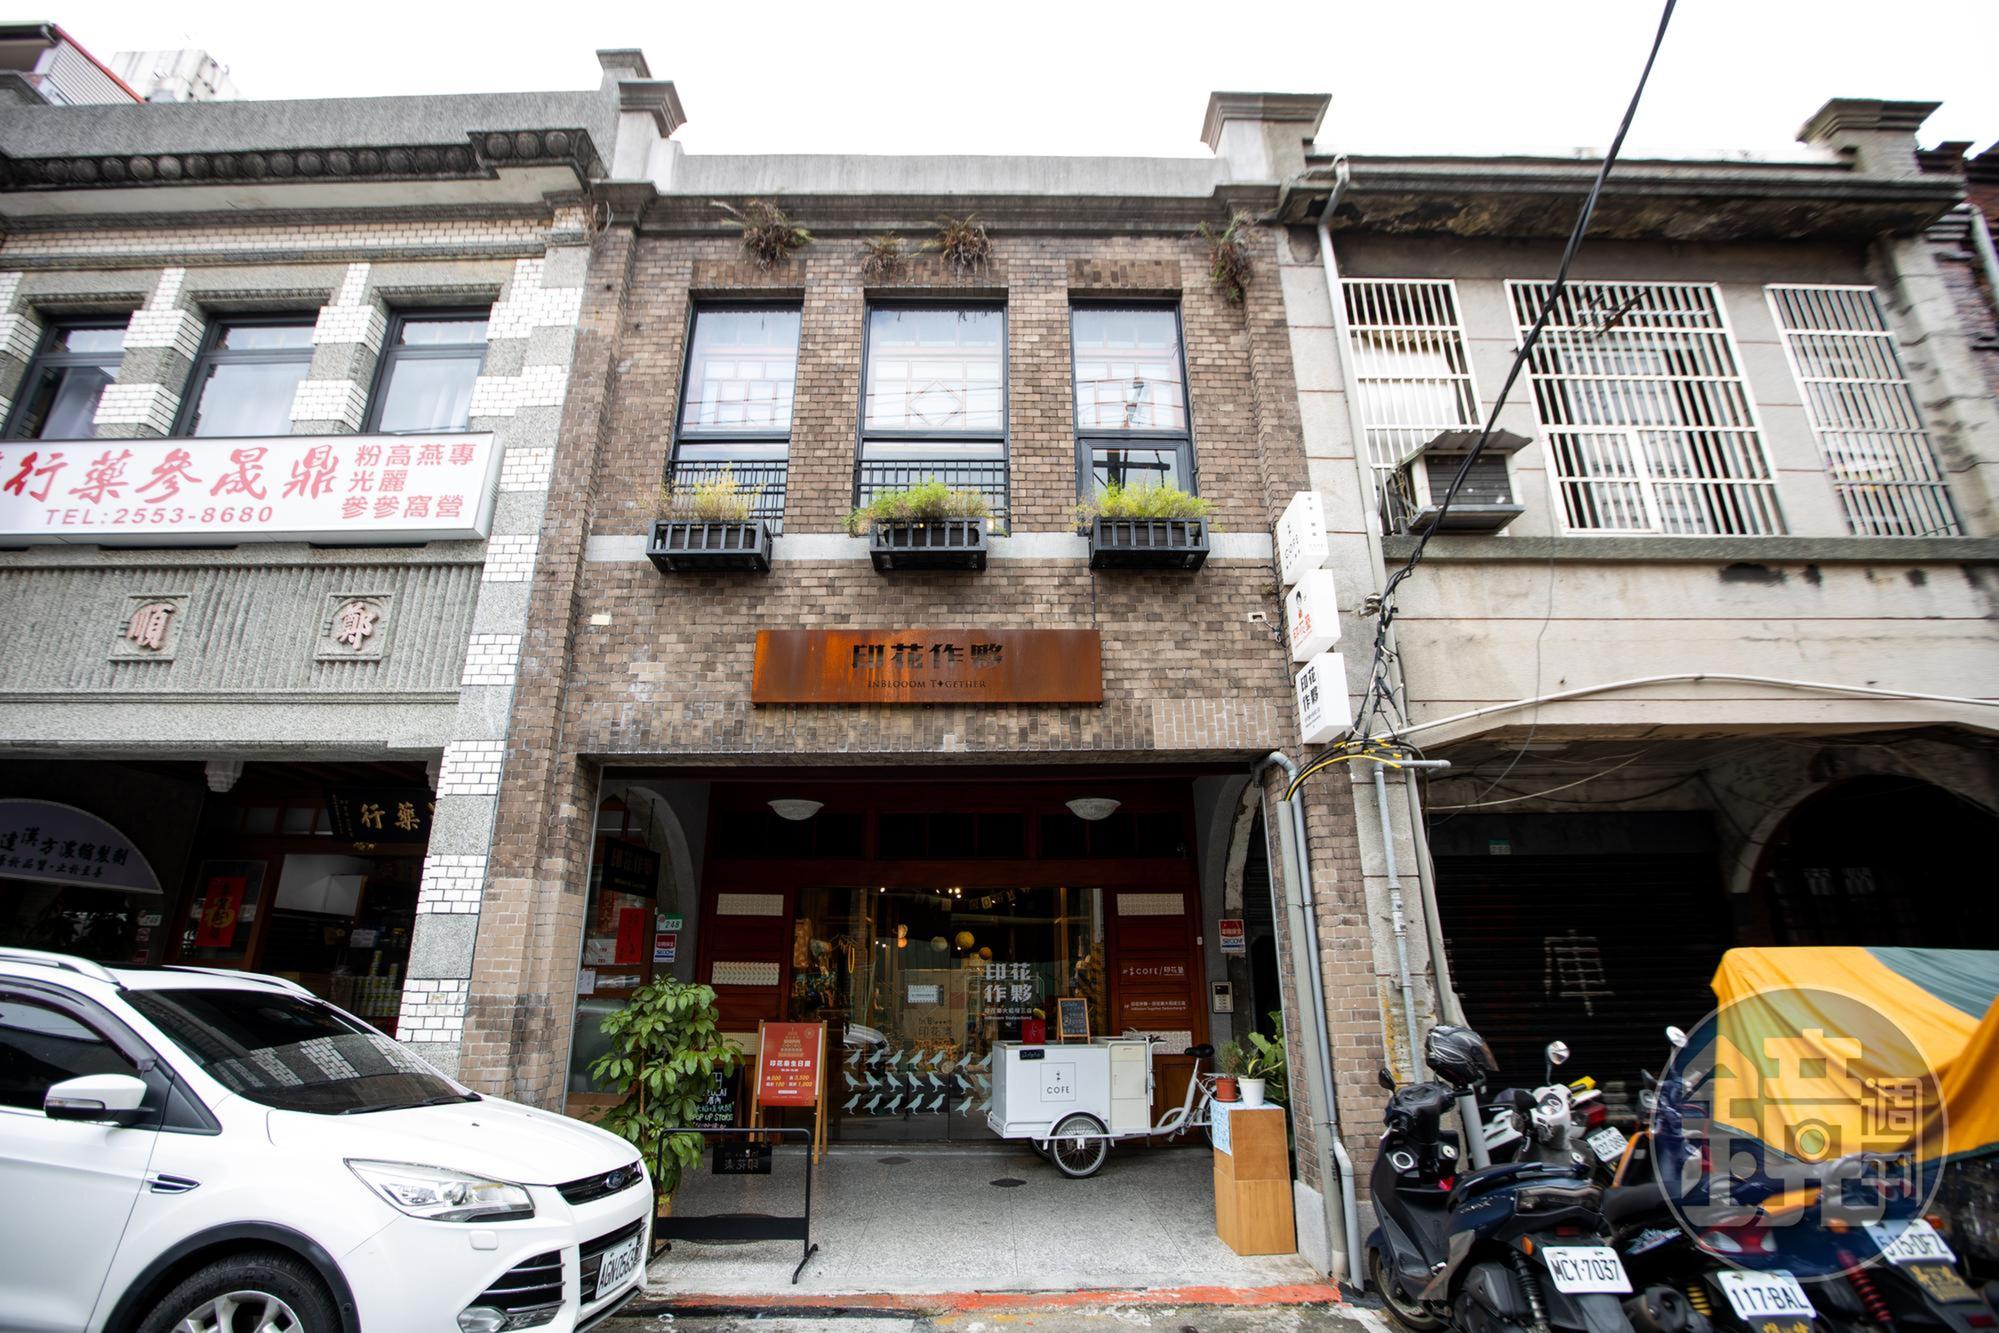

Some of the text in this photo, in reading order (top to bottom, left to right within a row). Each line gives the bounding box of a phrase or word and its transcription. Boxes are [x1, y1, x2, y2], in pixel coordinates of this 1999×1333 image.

[127, 604, 176, 650] 順
[336, 602, 378, 650] 鄭
[852, 643, 1003, 669] 印花作夥
[986, 962, 1030, 980] 印花
[984, 984, 1032, 1002] 作夥
[1046, 1086, 1070, 1094] COFE
